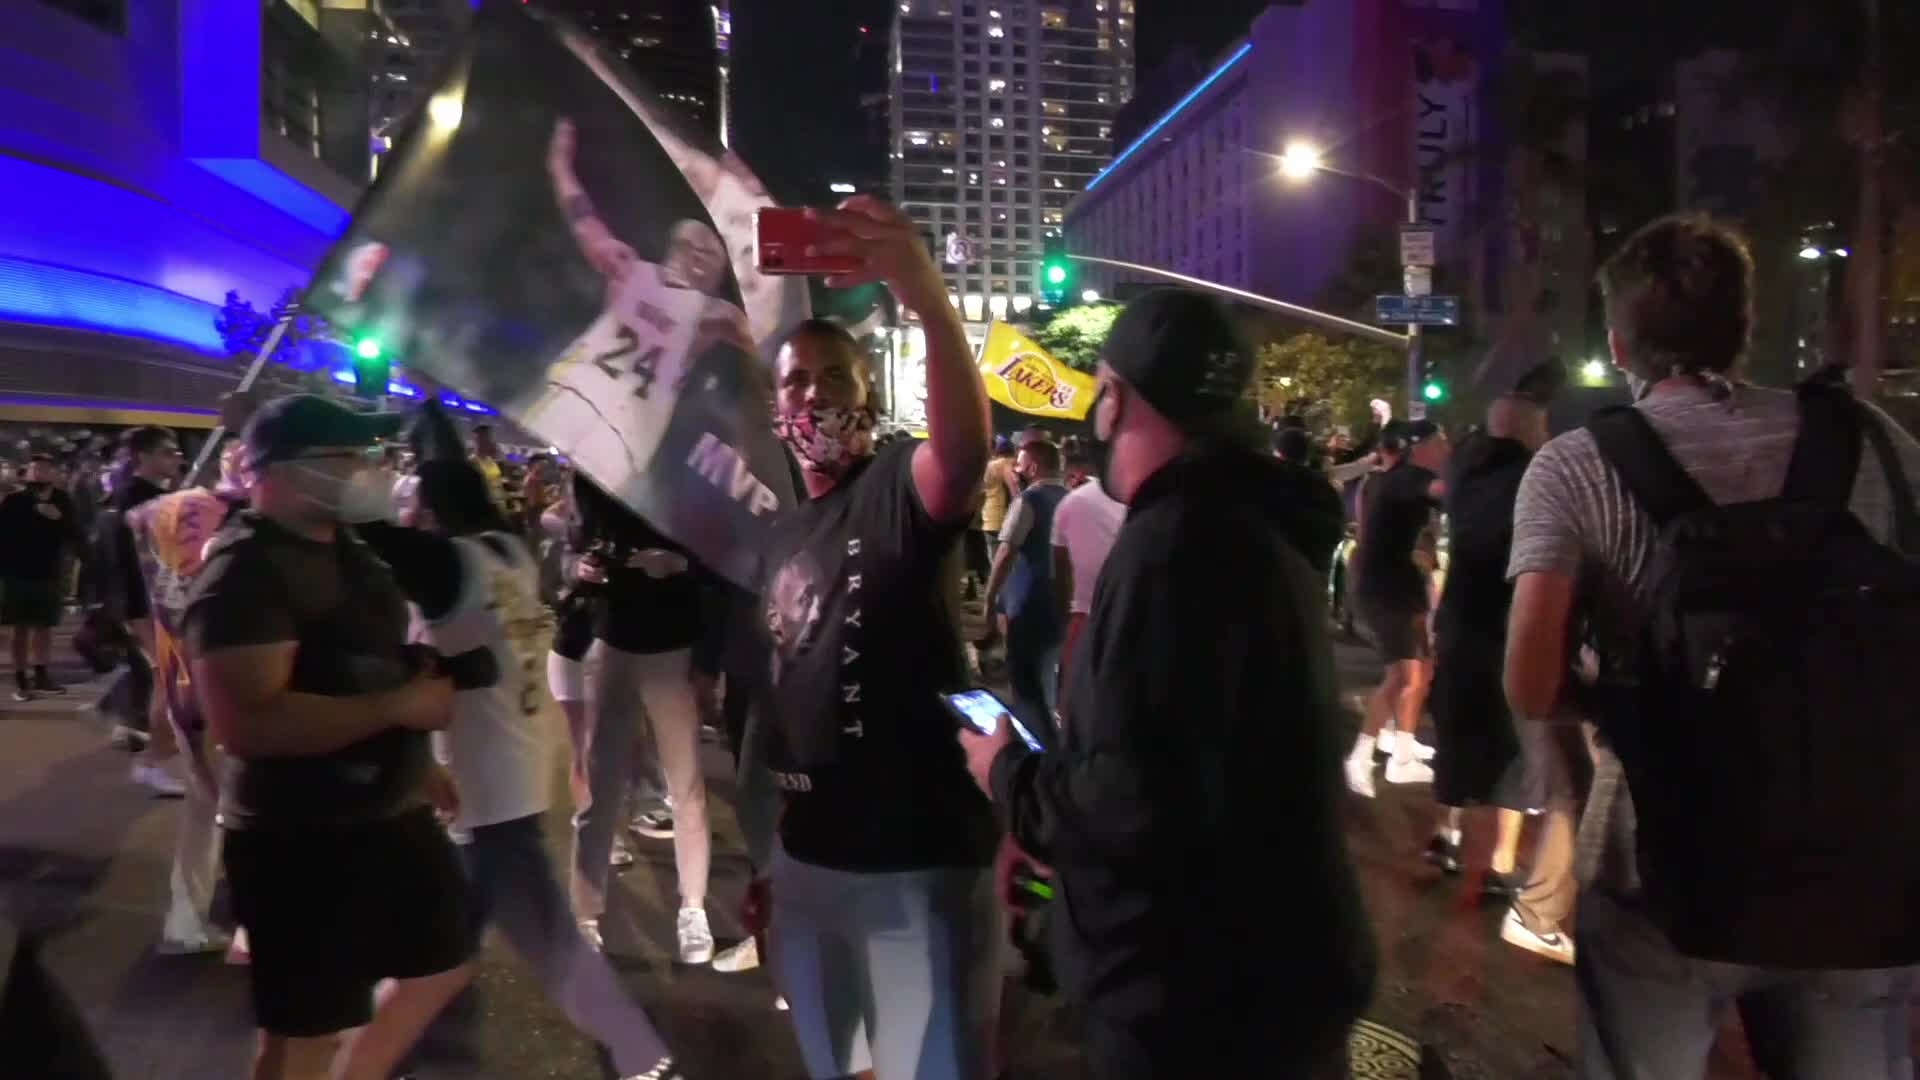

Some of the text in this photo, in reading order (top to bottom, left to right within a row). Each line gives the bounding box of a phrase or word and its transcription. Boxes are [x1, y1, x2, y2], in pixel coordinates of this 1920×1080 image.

[1417, 92, 1448, 226] TRULY
[592, 324, 664, 400] 24
[997, 356, 1066, 408] LAKERS
[686, 431, 780, 517] MVP
[841, 537, 865, 739] BRYANT
